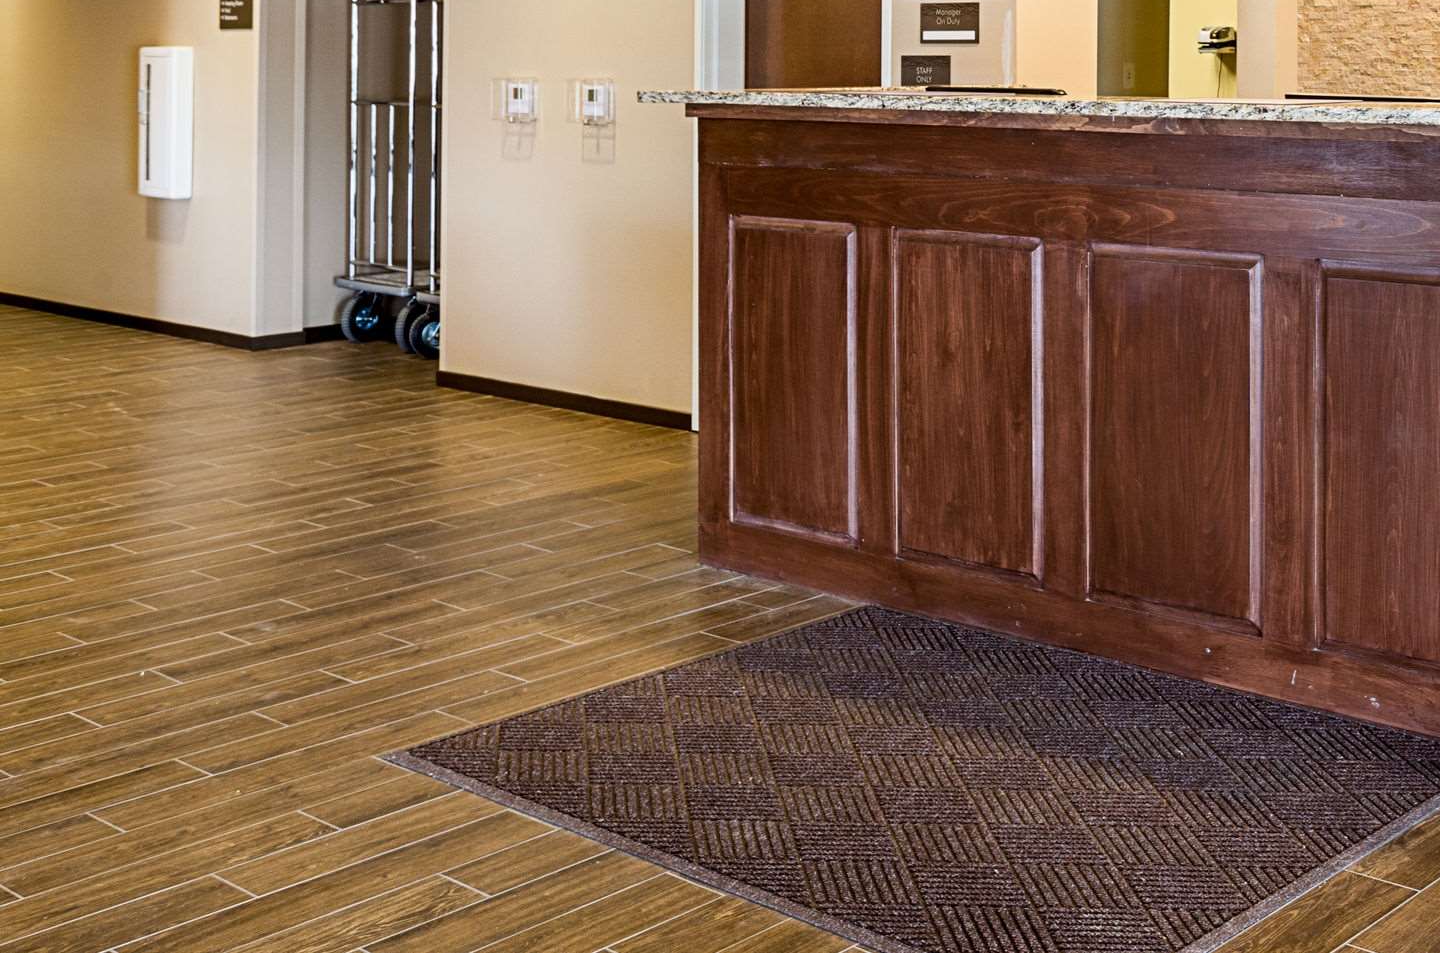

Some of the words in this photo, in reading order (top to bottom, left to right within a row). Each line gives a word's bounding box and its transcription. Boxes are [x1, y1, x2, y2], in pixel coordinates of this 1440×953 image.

[936, 9, 961, 17] Manager
[936, 17, 946, 25] On
[946, 17, 960, 26] Duty
[916, 66, 933, 75] STAFF
[916, 75, 932, 84] ONLY
